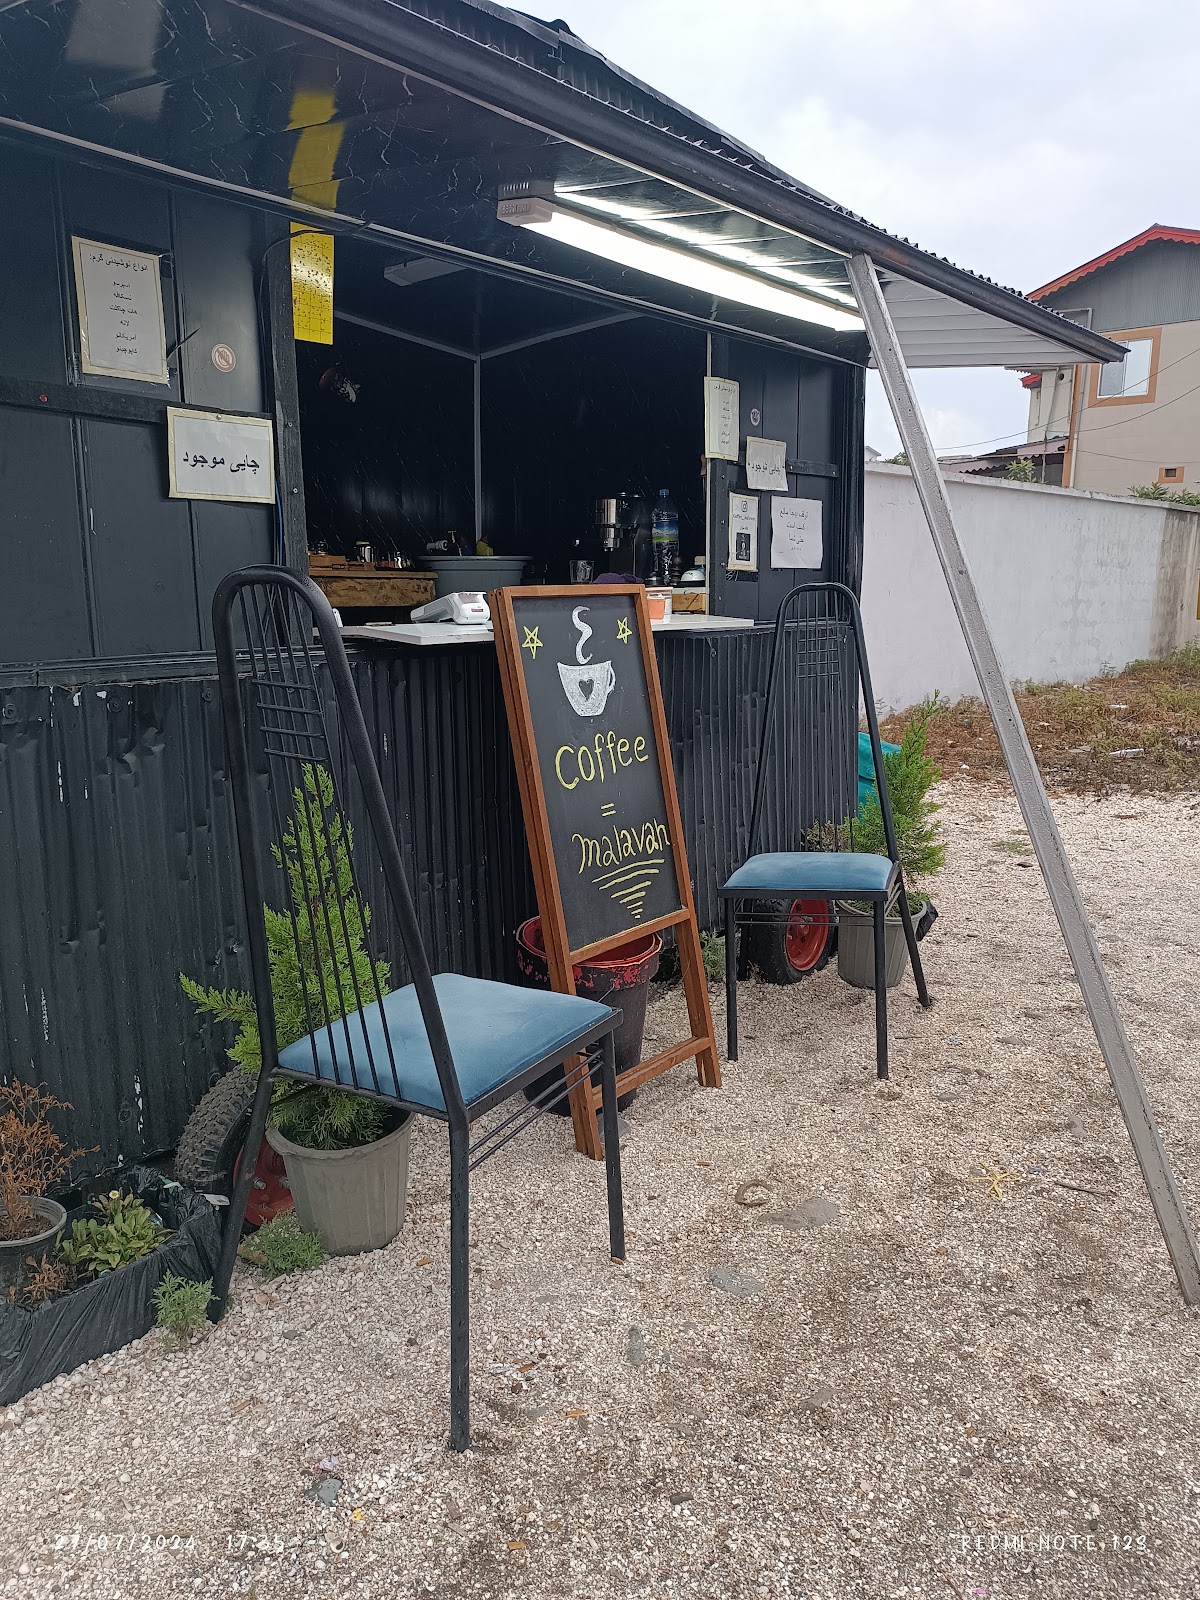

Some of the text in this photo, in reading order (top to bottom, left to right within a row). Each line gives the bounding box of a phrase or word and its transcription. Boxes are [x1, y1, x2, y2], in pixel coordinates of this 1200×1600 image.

[105, 256, 131, 269] نوشیدنی
[133, 262, 149, 272] انواع
[182, 451, 260, 475] چایی موجود
[555, 730, 649, 790] Coffee
